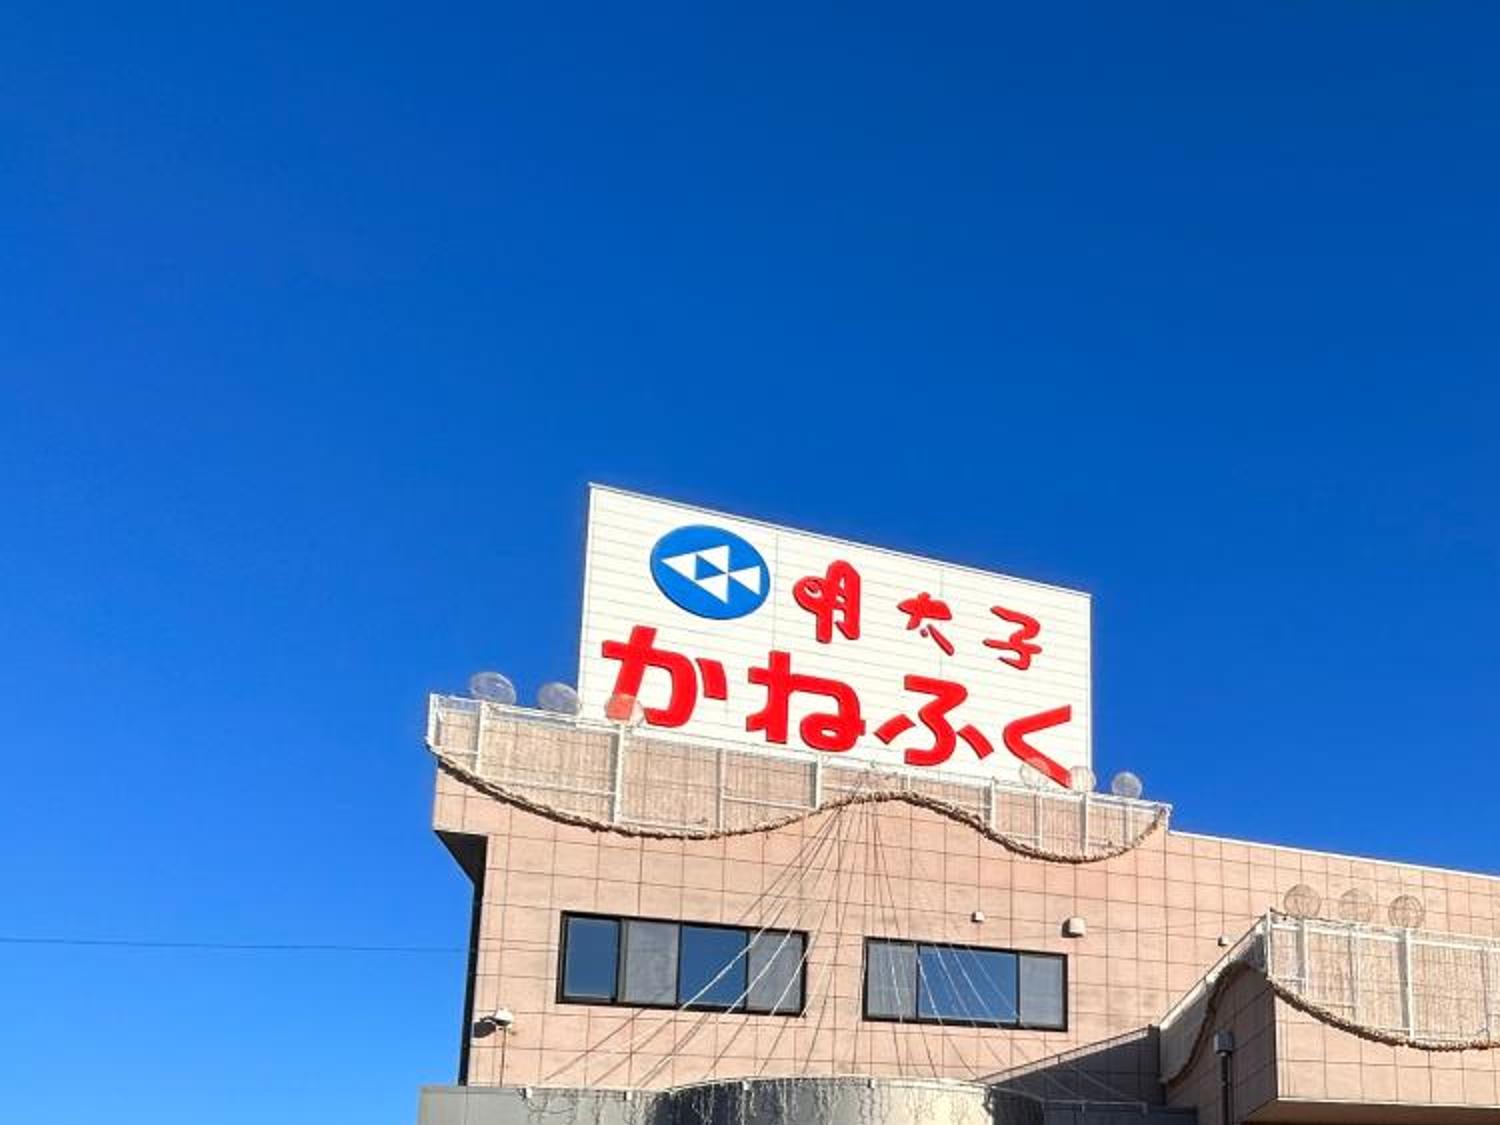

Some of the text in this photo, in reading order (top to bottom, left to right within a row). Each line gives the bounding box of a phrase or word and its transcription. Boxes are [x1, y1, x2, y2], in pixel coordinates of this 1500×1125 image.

[793, 559, 1042, 670] 明太子
[601, 625, 1072, 788] かねふく
